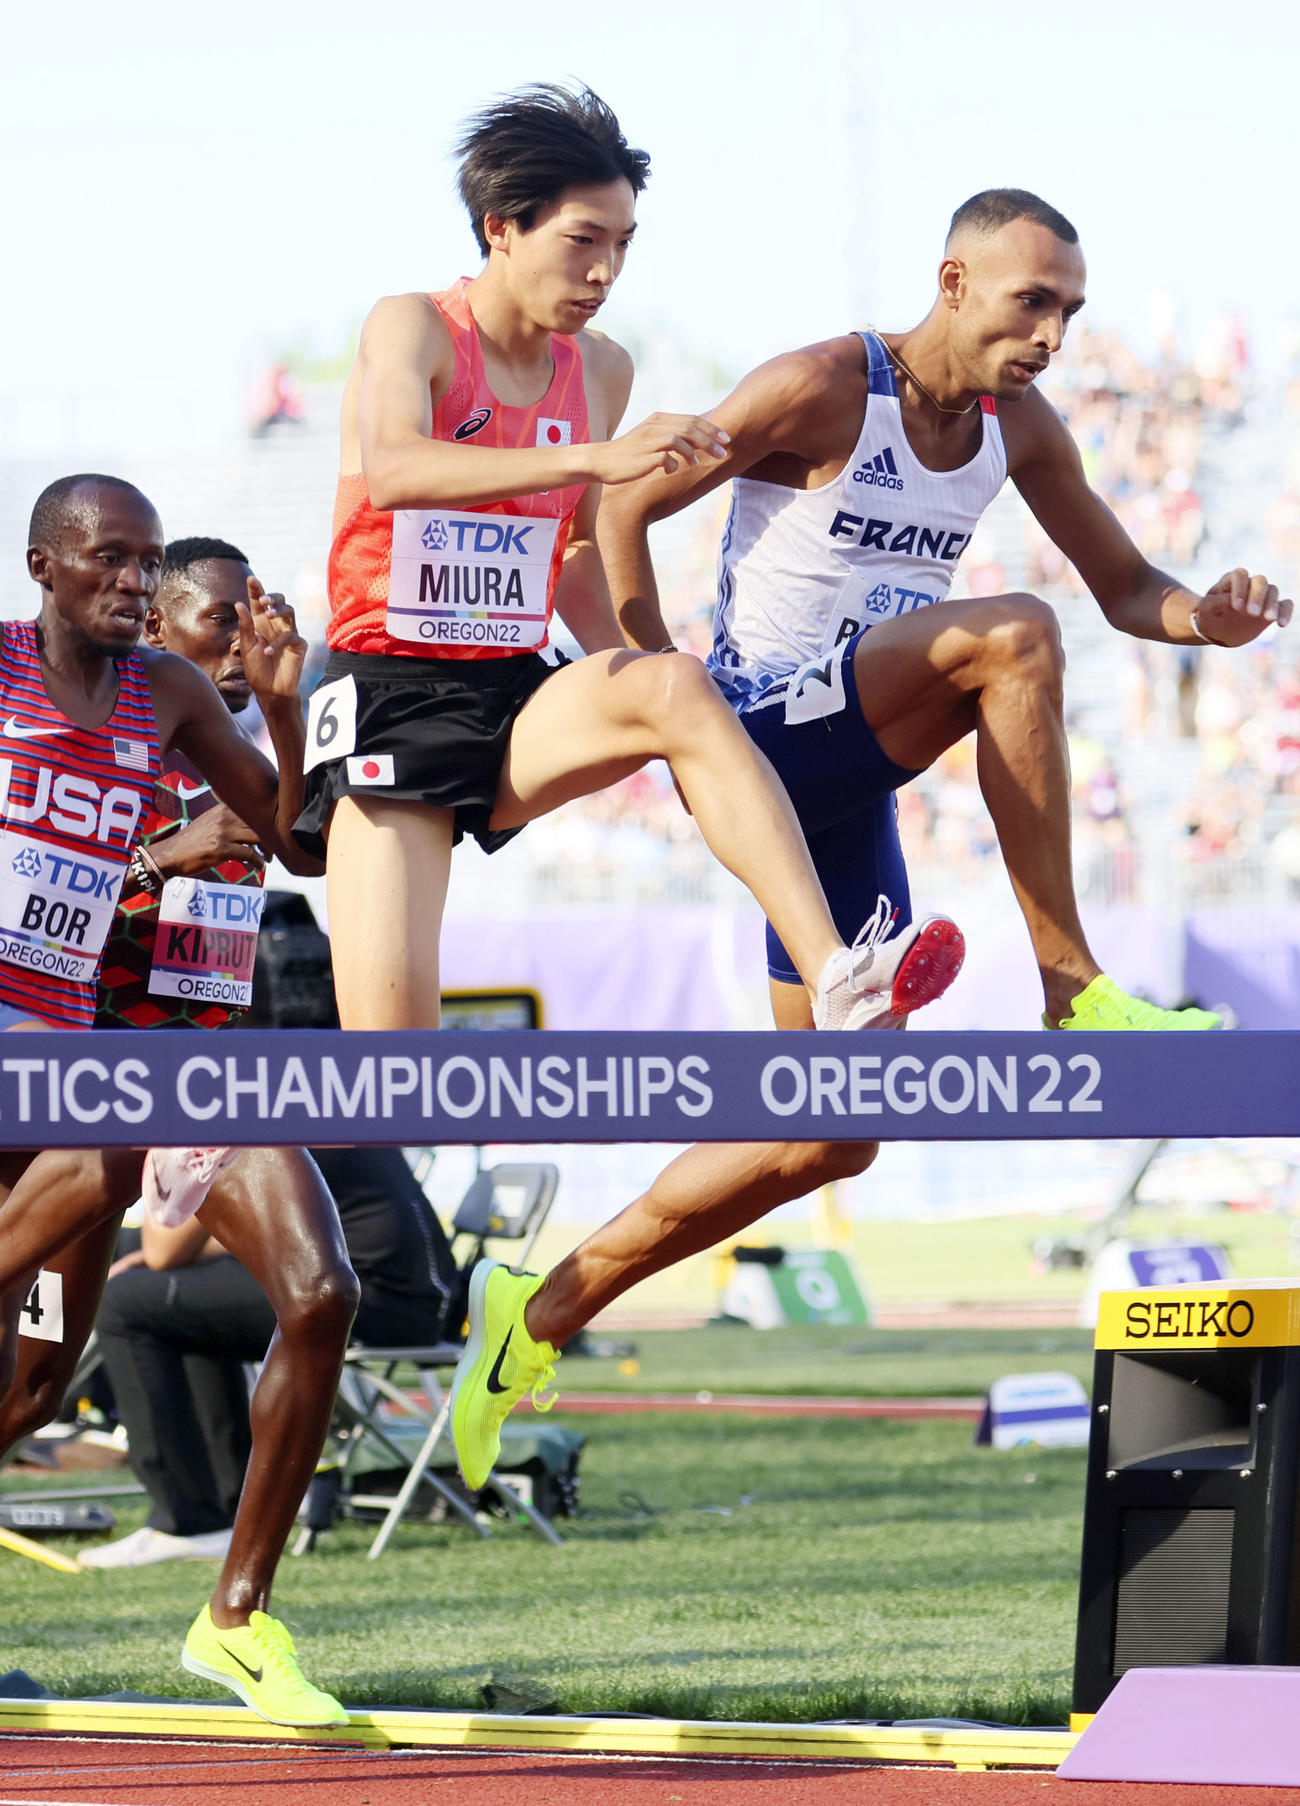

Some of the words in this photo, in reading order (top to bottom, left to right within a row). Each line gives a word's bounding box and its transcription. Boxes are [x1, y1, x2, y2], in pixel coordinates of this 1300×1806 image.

[853, 470, 904, 491] adidas
[448, 520, 535, 555] TDK
[419, 564, 525, 607] MIURA
[418, 620, 521, 643] OREGON22
[316, 697, 339, 748] 6
[0, 758, 142, 848] USA
[45, 853, 121, 902] TDK
[20, 893, 91, 946] BOR
[207, 891, 262, 923] TDK
[167, 925, 254, 969] KIPRUT
[176, 1055, 714, 1119] CHAMPIONSHIPS
[760, 1053, 1103, 1116] OREGON22
[22, 1283, 44, 1325] 4
[1125, 1300, 1255, 1338] SEIKO
